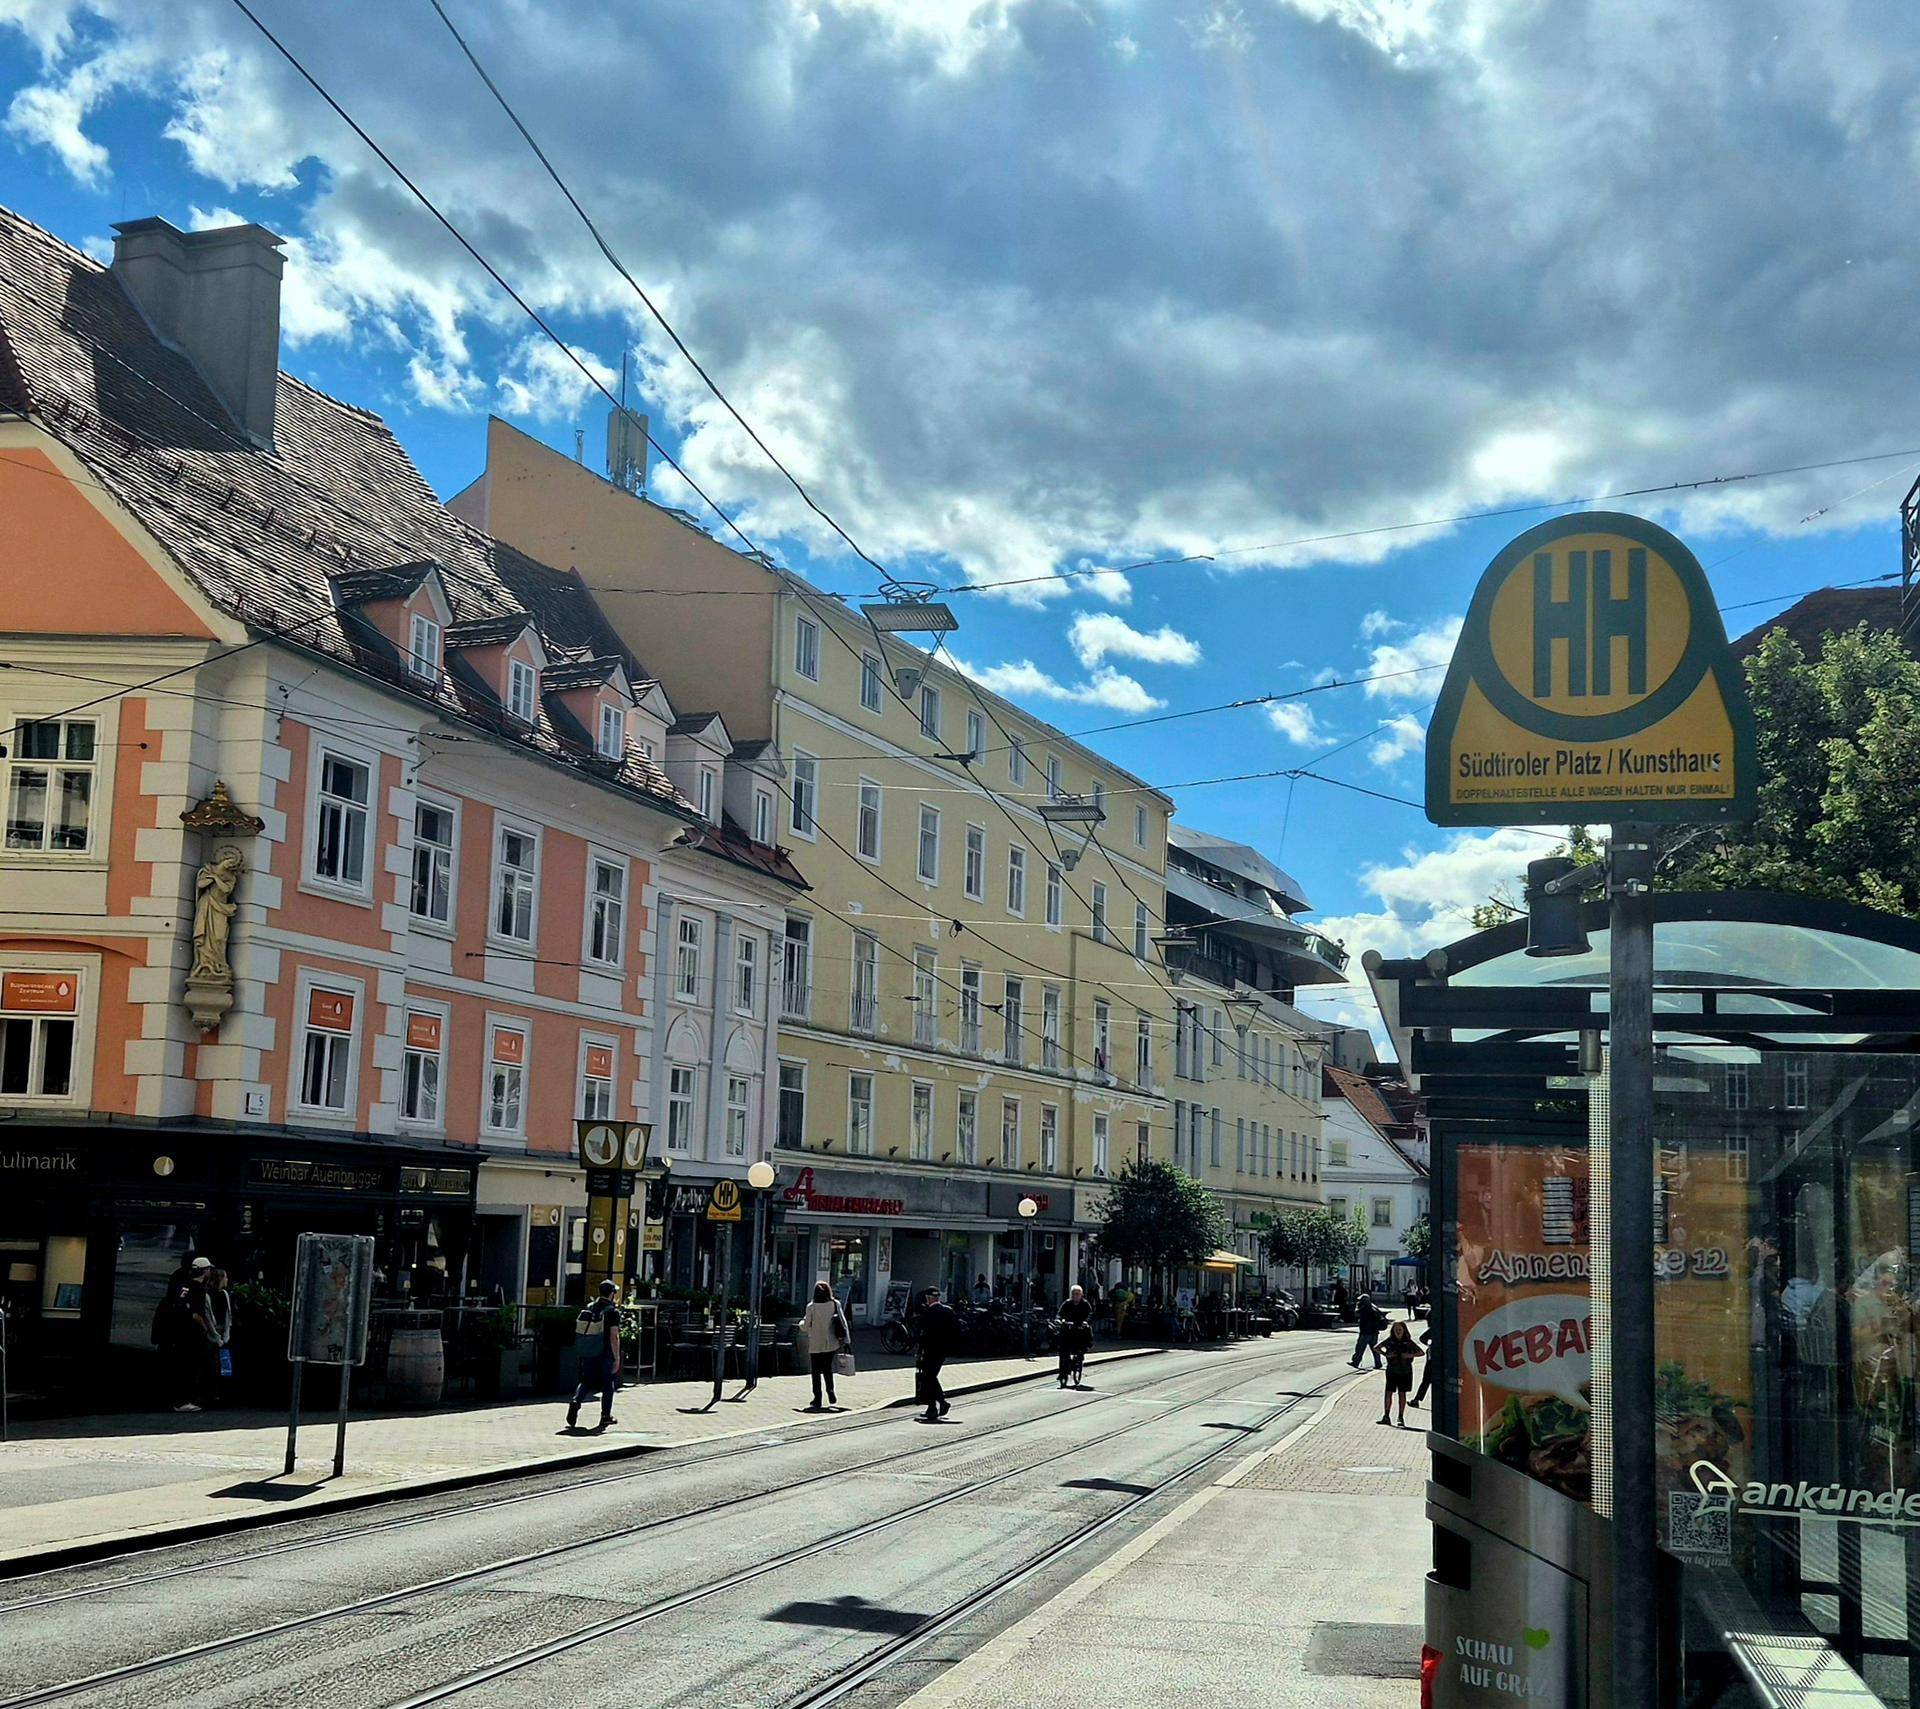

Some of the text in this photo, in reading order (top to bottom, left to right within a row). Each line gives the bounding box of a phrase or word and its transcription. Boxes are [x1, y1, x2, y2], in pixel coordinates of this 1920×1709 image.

[1459, 751, 1550, 777] Südtiroler
[1555, 750, 1602, 775] Platz
[1606, 749, 1613, 774] /
[1456, 784, 1730, 799] DOPPELHALTESTELLE ALLE WAGEN HALTEN NUR EINMAL!
[0, 1151, 76, 1170] ulinarik
[261, 1161, 382, 1189] Weinbar Auenbrugger
[1691, 1246, 1728, 1274] 12
[1455, 1635, 1514, 1666] SCHAU
[1460, 1663, 1548, 1697] AUF GRAZ
